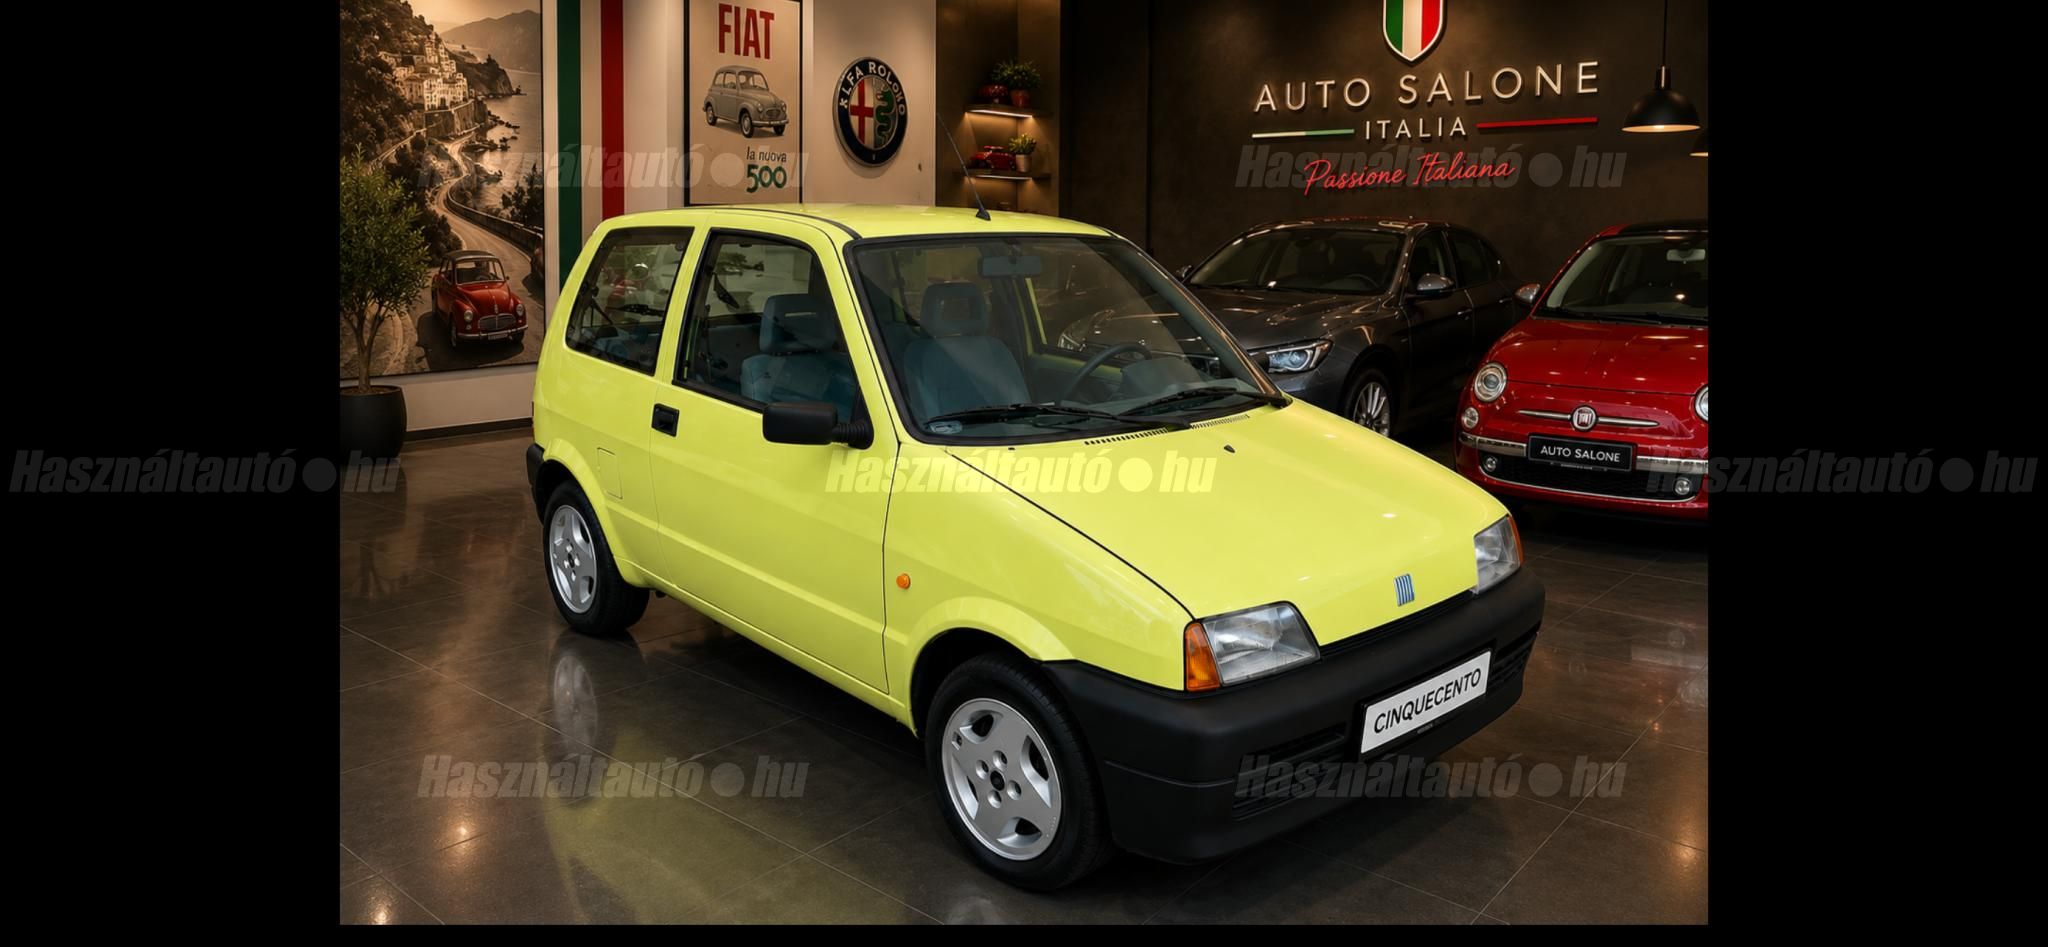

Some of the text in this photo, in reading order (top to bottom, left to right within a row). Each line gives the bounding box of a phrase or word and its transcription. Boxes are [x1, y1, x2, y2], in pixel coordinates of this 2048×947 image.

[718, 3, 775, 60] FIAT
[1253, 61, 1599, 112] AUTO SALONE
[1364, 116, 1467, 140] ITALIA
[746, 146, 788, 163] la nuova
[745, 164, 788, 194] 500
[1303, 151, 1518, 196] Passione Italiana
[1540, 445, 1621, 463] AUTO SALONE
[1373, 668, 1482, 735] CINQUECENTO
